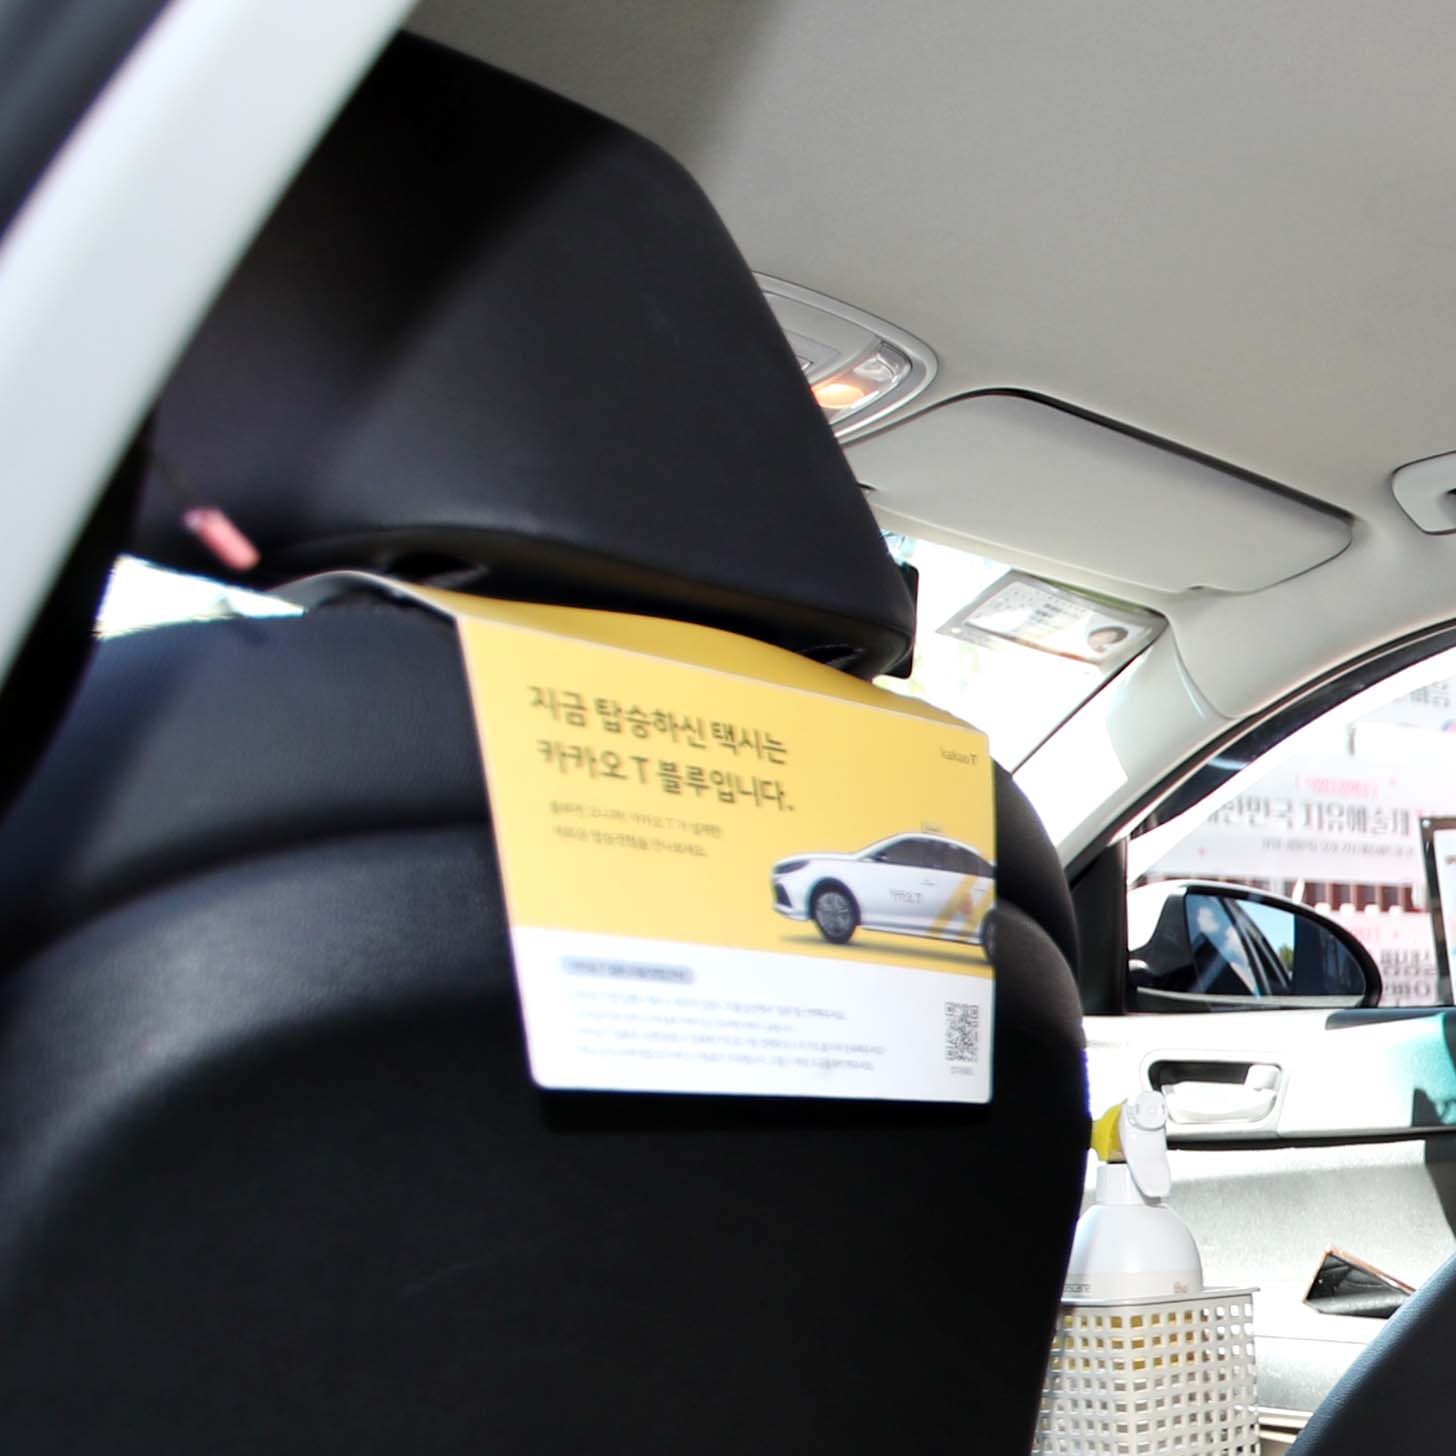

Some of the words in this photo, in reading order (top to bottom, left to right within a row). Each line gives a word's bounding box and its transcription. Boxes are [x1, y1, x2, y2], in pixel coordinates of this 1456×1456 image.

[528, 685, 587, 729] 지금
[593, 697, 707, 750] 탑승하신
[711, 720, 788, 765] 택시는
[536, 739, 628, 781] 카카오
[629, 754, 651, 785] T
[656, 758, 795, 812] 블루입니다.
